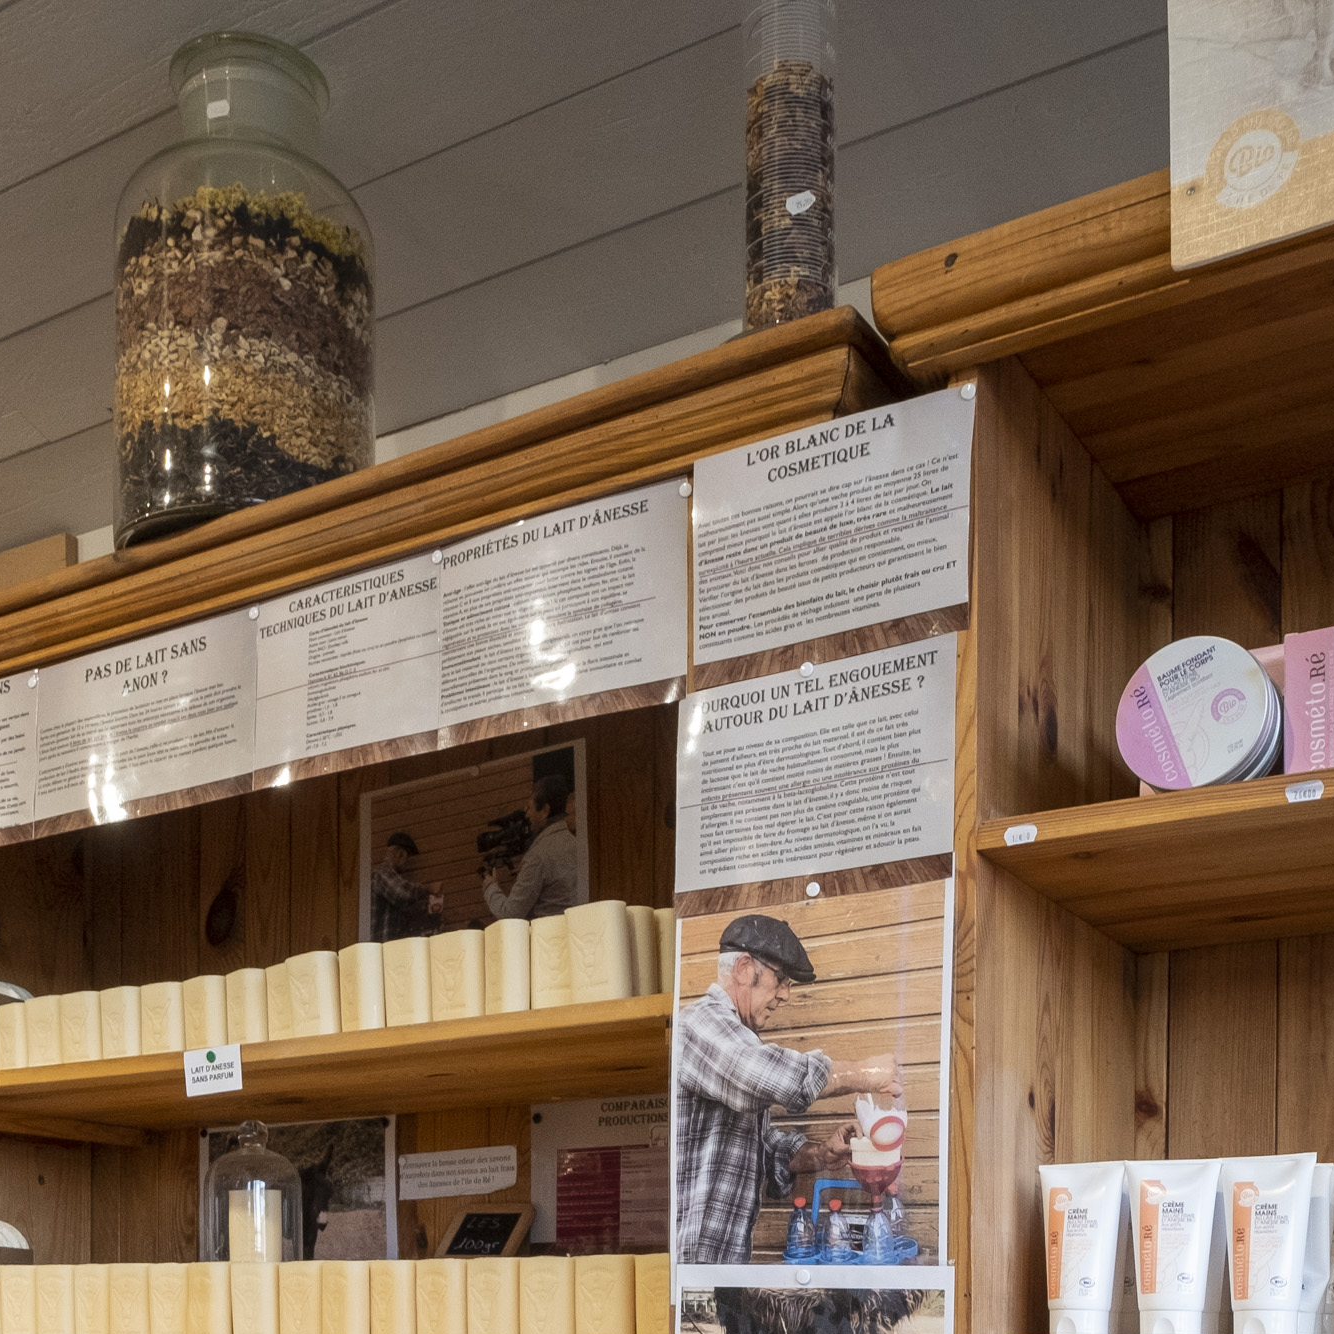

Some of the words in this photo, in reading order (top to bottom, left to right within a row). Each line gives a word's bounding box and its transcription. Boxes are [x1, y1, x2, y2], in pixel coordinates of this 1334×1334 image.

[746, 444, 779, 466] L'OR
[785, 427, 840, 460] BLANC
[844, 420, 866, 439] DE
[871, 413, 895, 431] LA
[768, 442, 871, 482] COSMETIQUE
[443, 534, 518, 570] PROPRIÉTÉS
[522, 528, 540, 544] DU
[543, 519, 575, 538] LAIT
[579, 500, 649, 529] D'ÂNESSE
[259, 609, 326, 639] TECHNIQUES
[329, 604, 344, 618] DU
[347, 595, 375, 613] LAIT
[379, 577, 437, 604] D'ANESSE
[289, 570, 405, 613] CARACTERISTIQUES
[85, 663, 111, 683] PAS
[115, 658, 132, 675] DE
[136, 647, 167, 669] LAIT
[170, 636, 207, 659] SANS
[770, 684, 791, 700] UN
[794, 677, 824, 695] TEL
[829, 650, 938, 688] ENGOUEMENT
[122, 672, 158, 696] ANON
[162, 669, 168, 684] ?
[702, 711, 763, 734] AUTOUR
[768, 705, 788, 721] DU
[793, 695, 829, 716] LAIT
[834, 677, 912, 708] D'ÂNESSE
[916, 675, 925, 688] ?
[190, 1065, 204, 1074] LAIT
[205, 1061, 234, 1073] D'ANESSE
[192, 1075, 208, 1084] SANS
[209, 1071, 234, 1081] PARFUM
[467, 1216, 500, 1228] LES
[1162, 1200, 1185, 1209] CRÈME
[454, 1238, 500, 1254] 100gr
